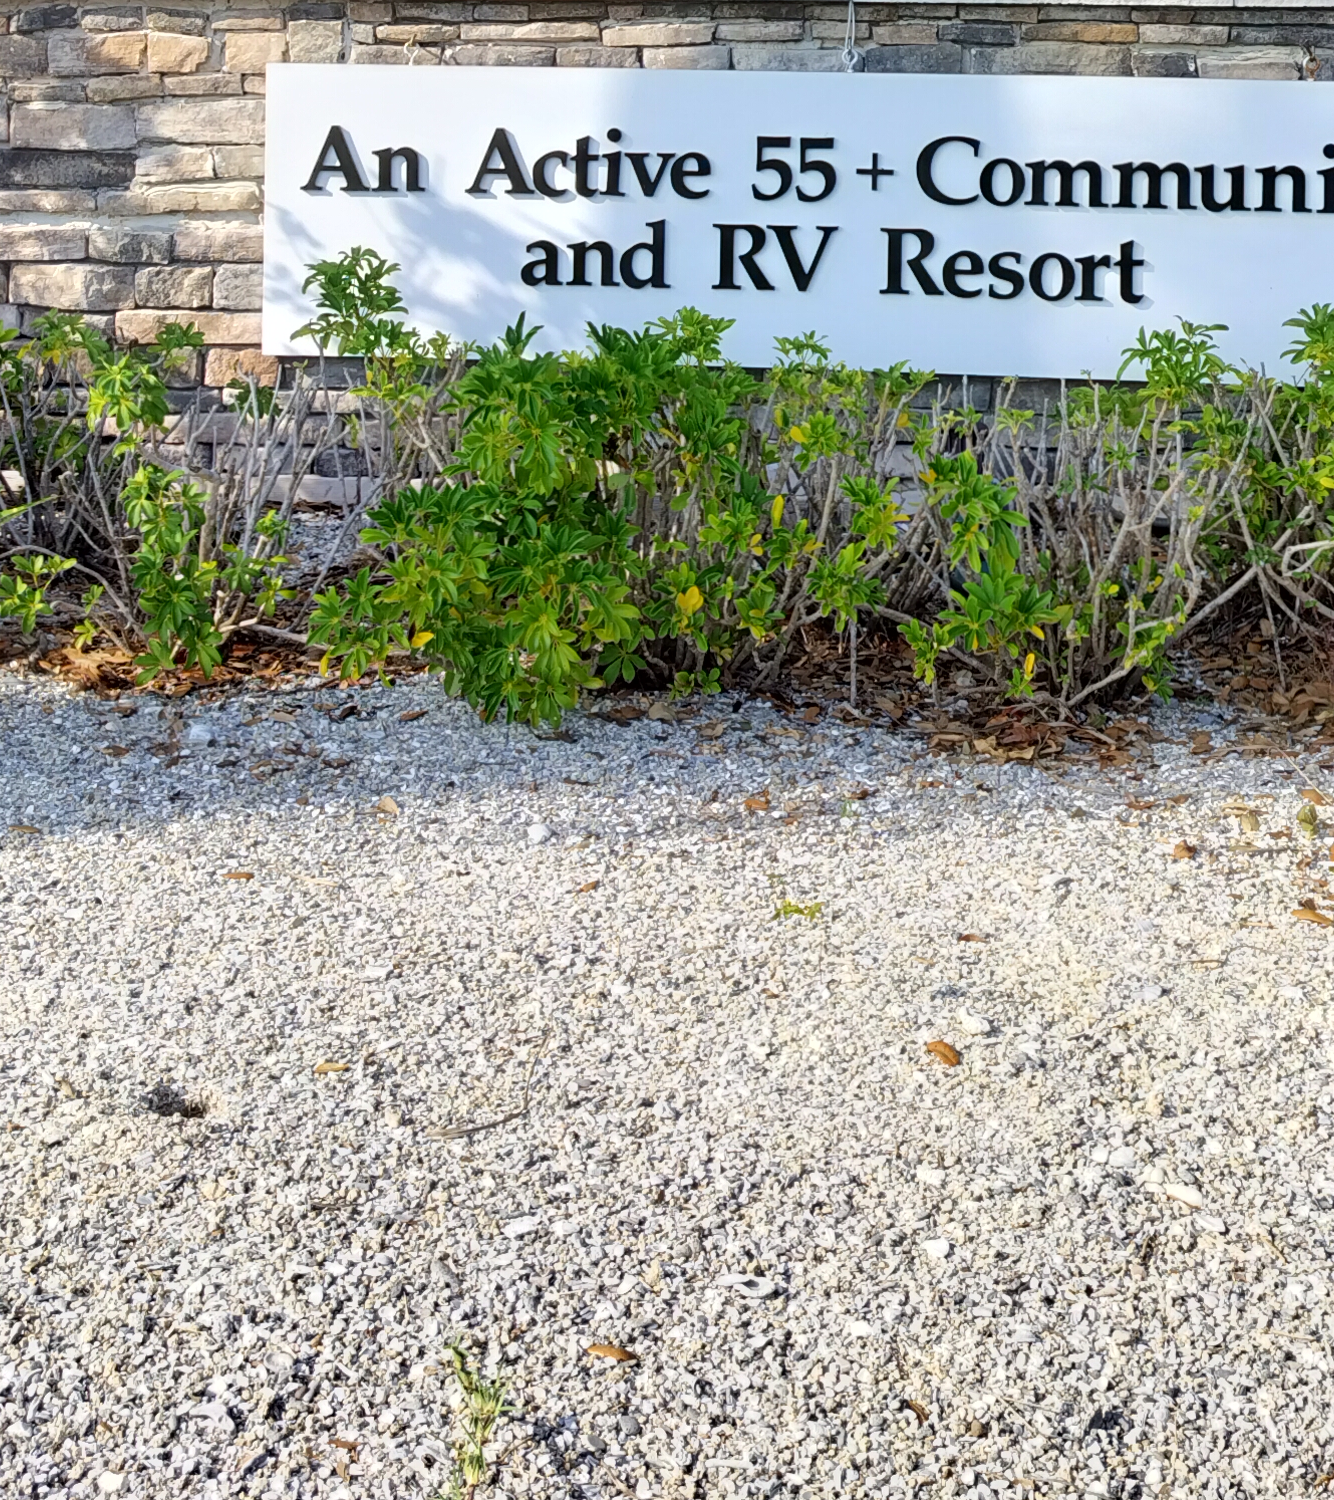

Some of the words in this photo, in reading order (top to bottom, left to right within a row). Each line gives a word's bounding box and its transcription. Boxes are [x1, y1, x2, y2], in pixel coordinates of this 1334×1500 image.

[300, 125, 426, 193] An
[466, 127, 712, 199] Active
[520, 221, 670, 290] and
[711, 223, 839, 293] RV
[879, 227, 1146, 305] Resort
